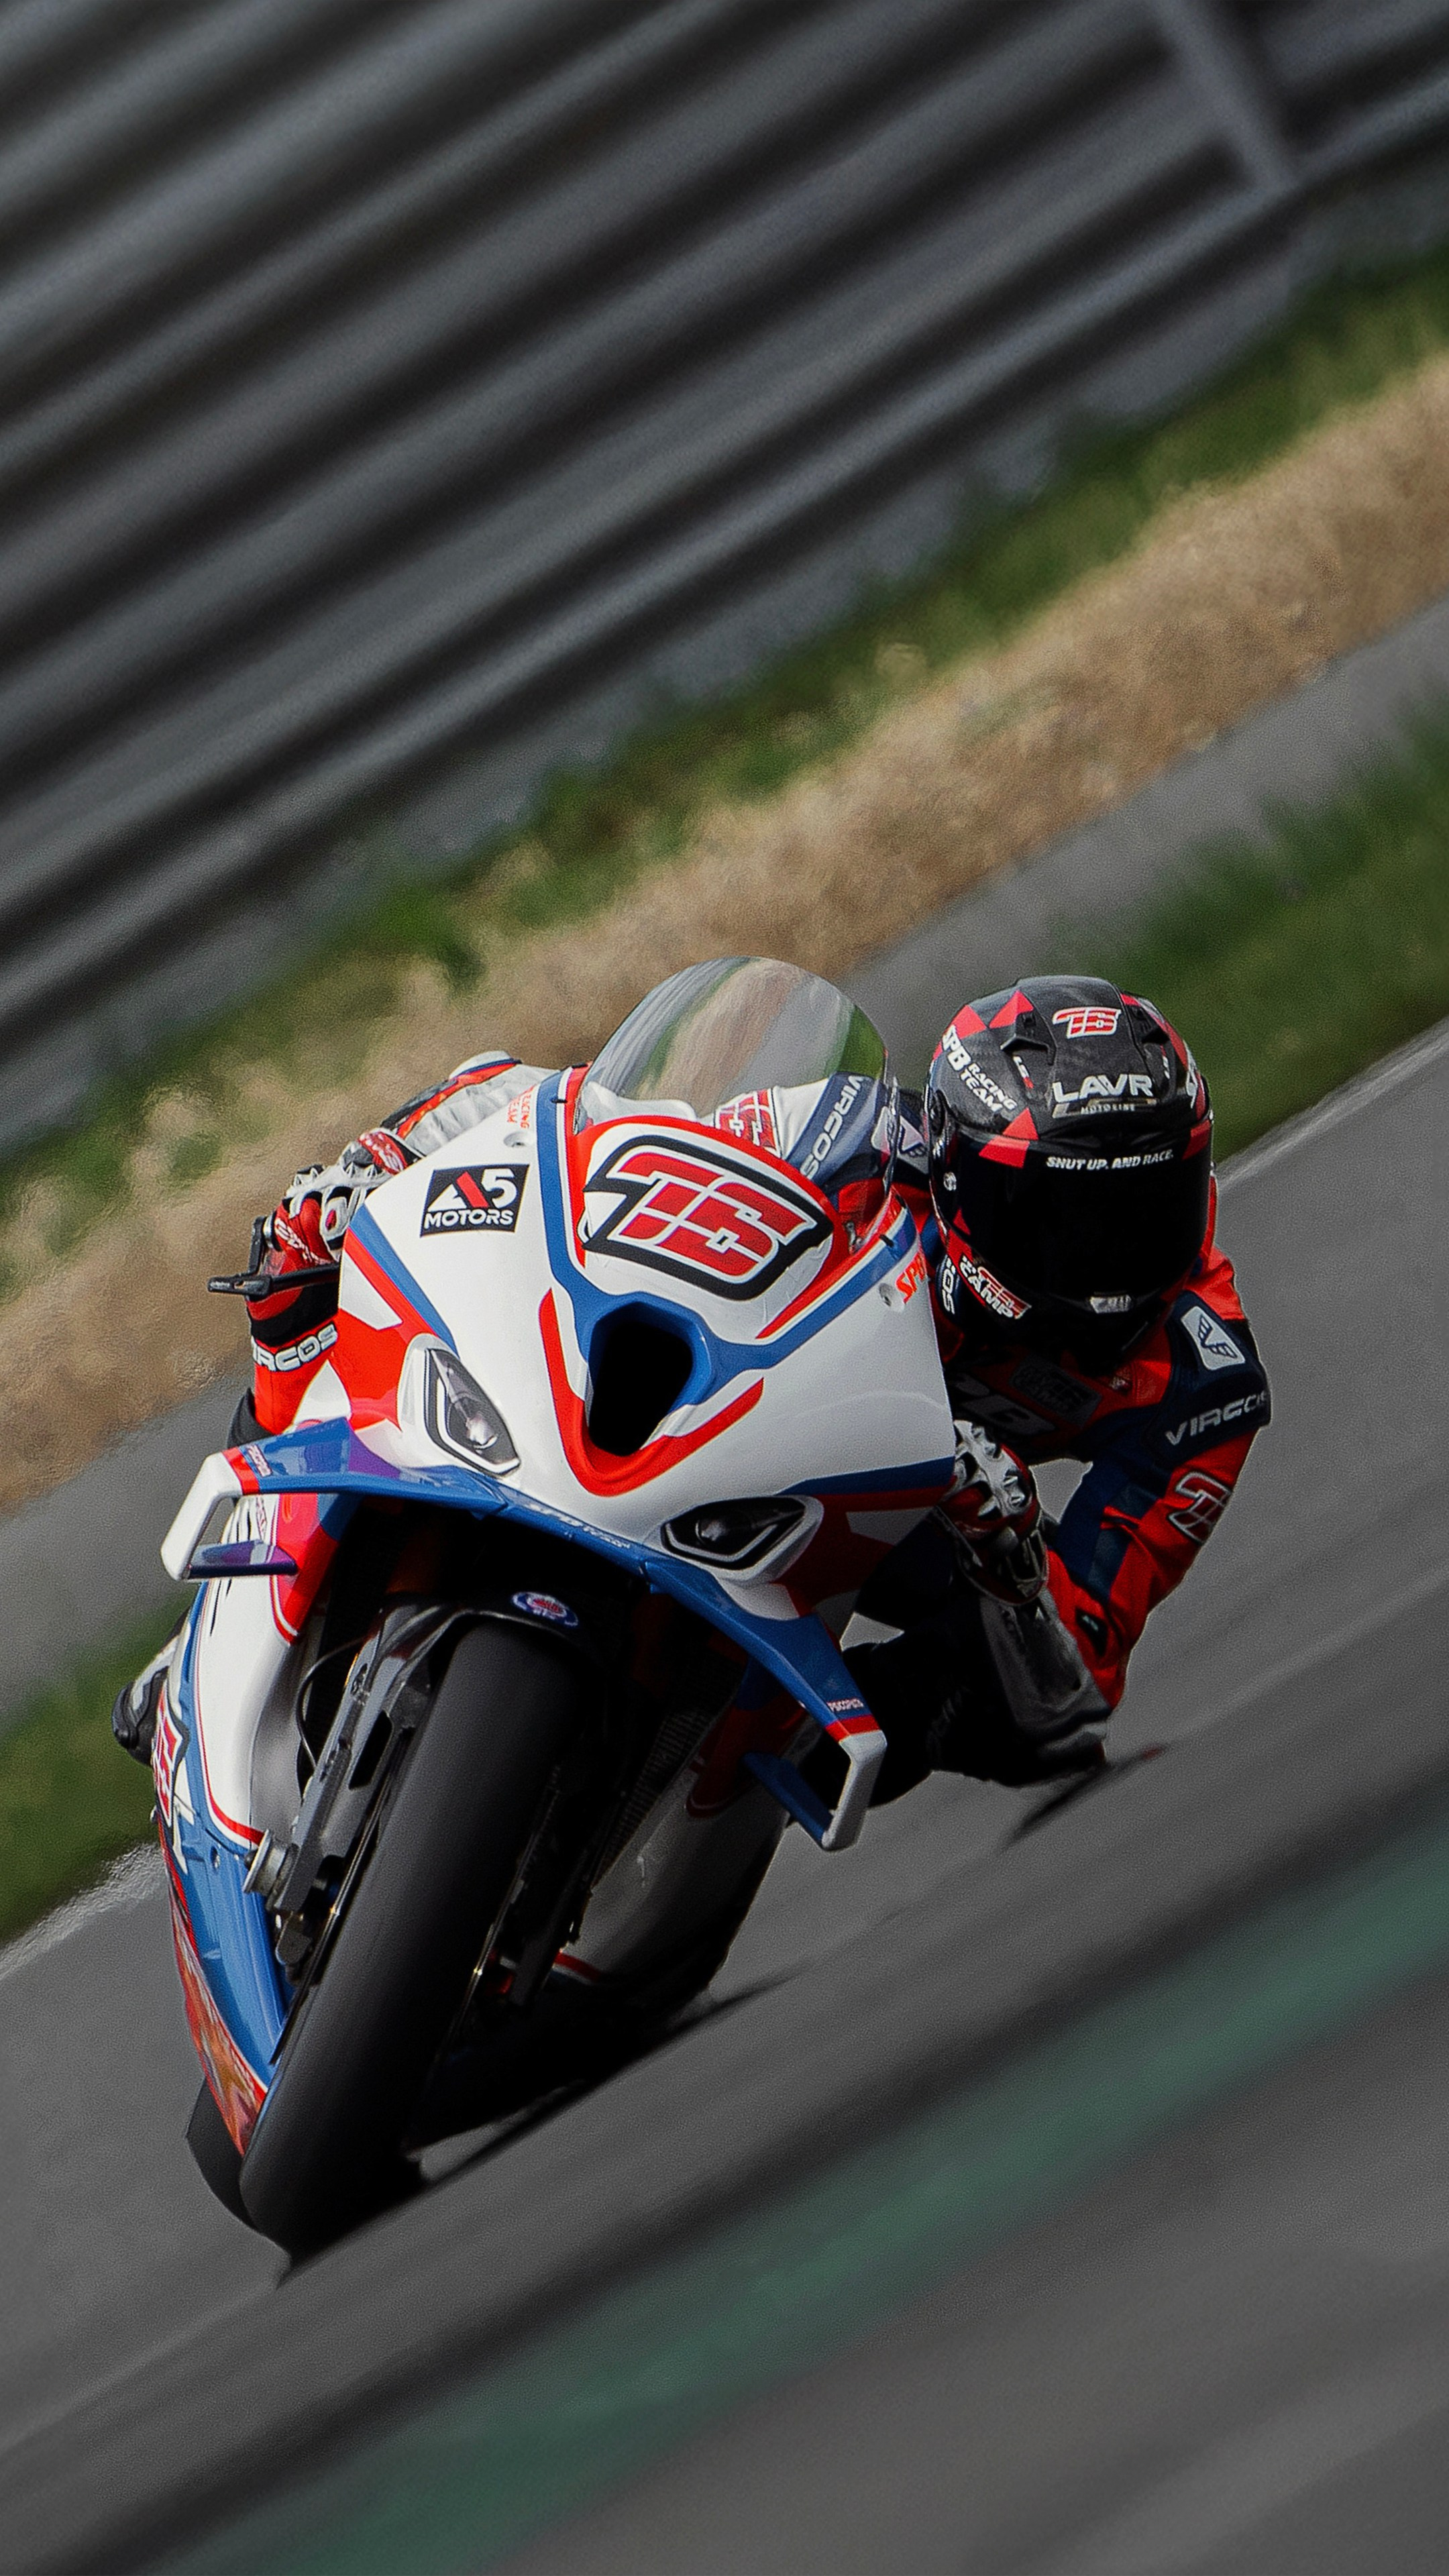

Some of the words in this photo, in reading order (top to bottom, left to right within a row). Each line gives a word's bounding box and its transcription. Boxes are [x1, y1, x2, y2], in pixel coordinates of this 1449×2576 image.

[960, 1068, 1003, 1112] TEAM
[968, 1063, 1018, 1110] RACING
[1052, 1073, 1154, 1104] LAVR
[800, 1075, 864, 1180] VIRCOS
[1046, 1156, 1086, 1170] SHUT
[1111, 1155, 1141, 1170] AND
[424, 1209, 514, 1230] MOTORS
[959, 1261, 1014, 1318] CAMP
